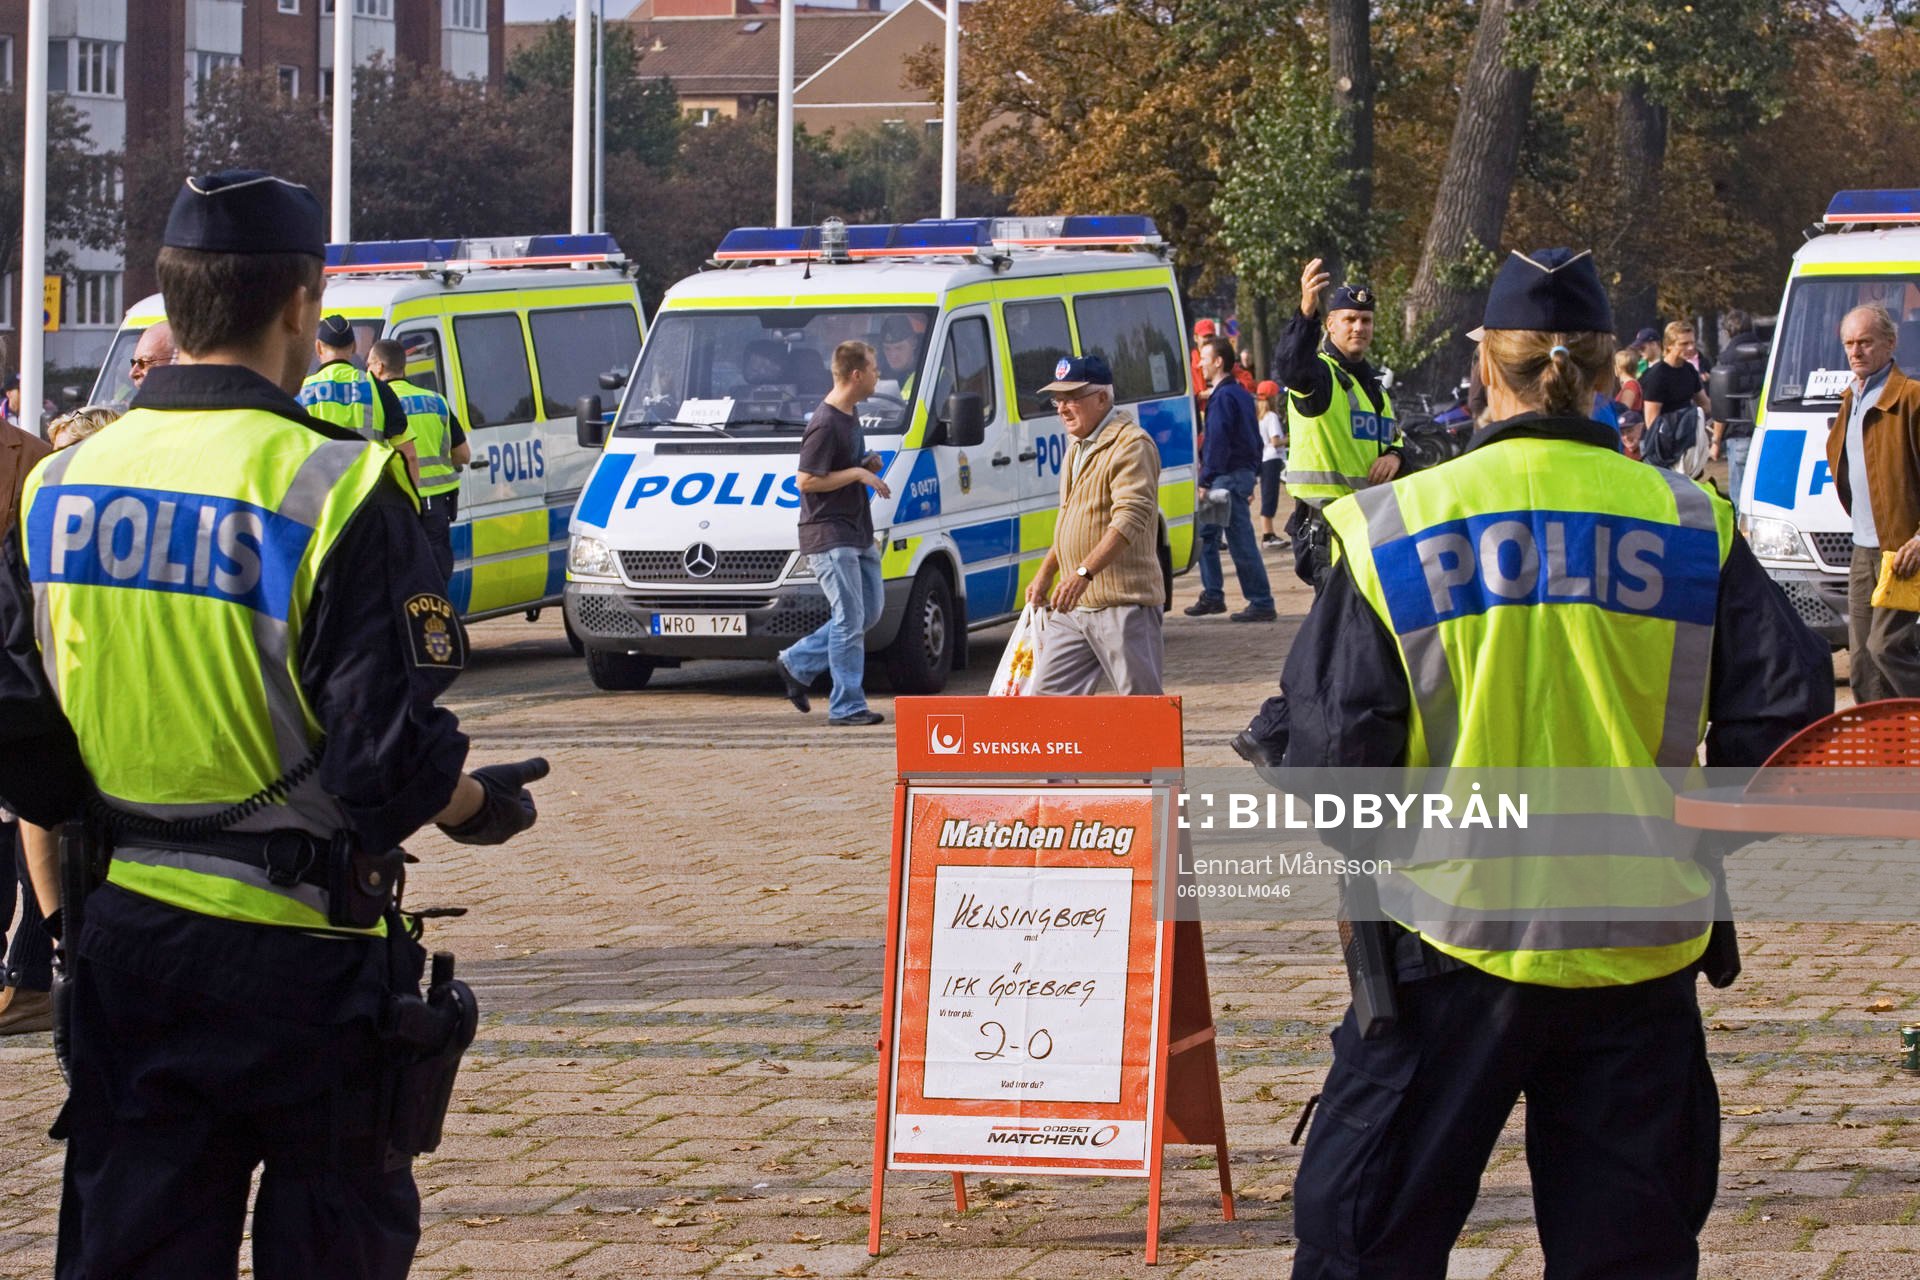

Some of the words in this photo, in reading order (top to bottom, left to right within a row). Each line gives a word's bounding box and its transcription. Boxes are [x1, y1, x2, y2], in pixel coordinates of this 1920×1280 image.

[400, 395, 439, 415] OLIS
[488, 438, 545, 484] POLIS
[624, 472, 800, 509] POLIS
[49, 494, 263, 595] POLIS
[1415, 519, 1667, 613] POLIS
[408, 597, 451, 618] POLIS
[711, 617, 742, 633] 174
[972, 741, 1042, 755] SVENSKA
[1046, 741, 1083, 755] SPEL
[938, 819, 1066, 850] Matchen
[1069, 820, 1137, 856] idag
[951, 893, 1107, 938] HELSINGBORG
[942, 975, 981, 998] IFK
[939, 1009, 947, 1017] Vi
[947, 1009, 961, 1018] tror
[1000, 1080, 1014, 1088] Vad
[1029, 1080, 1045, 1089] du?
[986, 1132, 1089, 1146] MATCHEN
[1043, 1125, 1091, 1133] ODDSET
